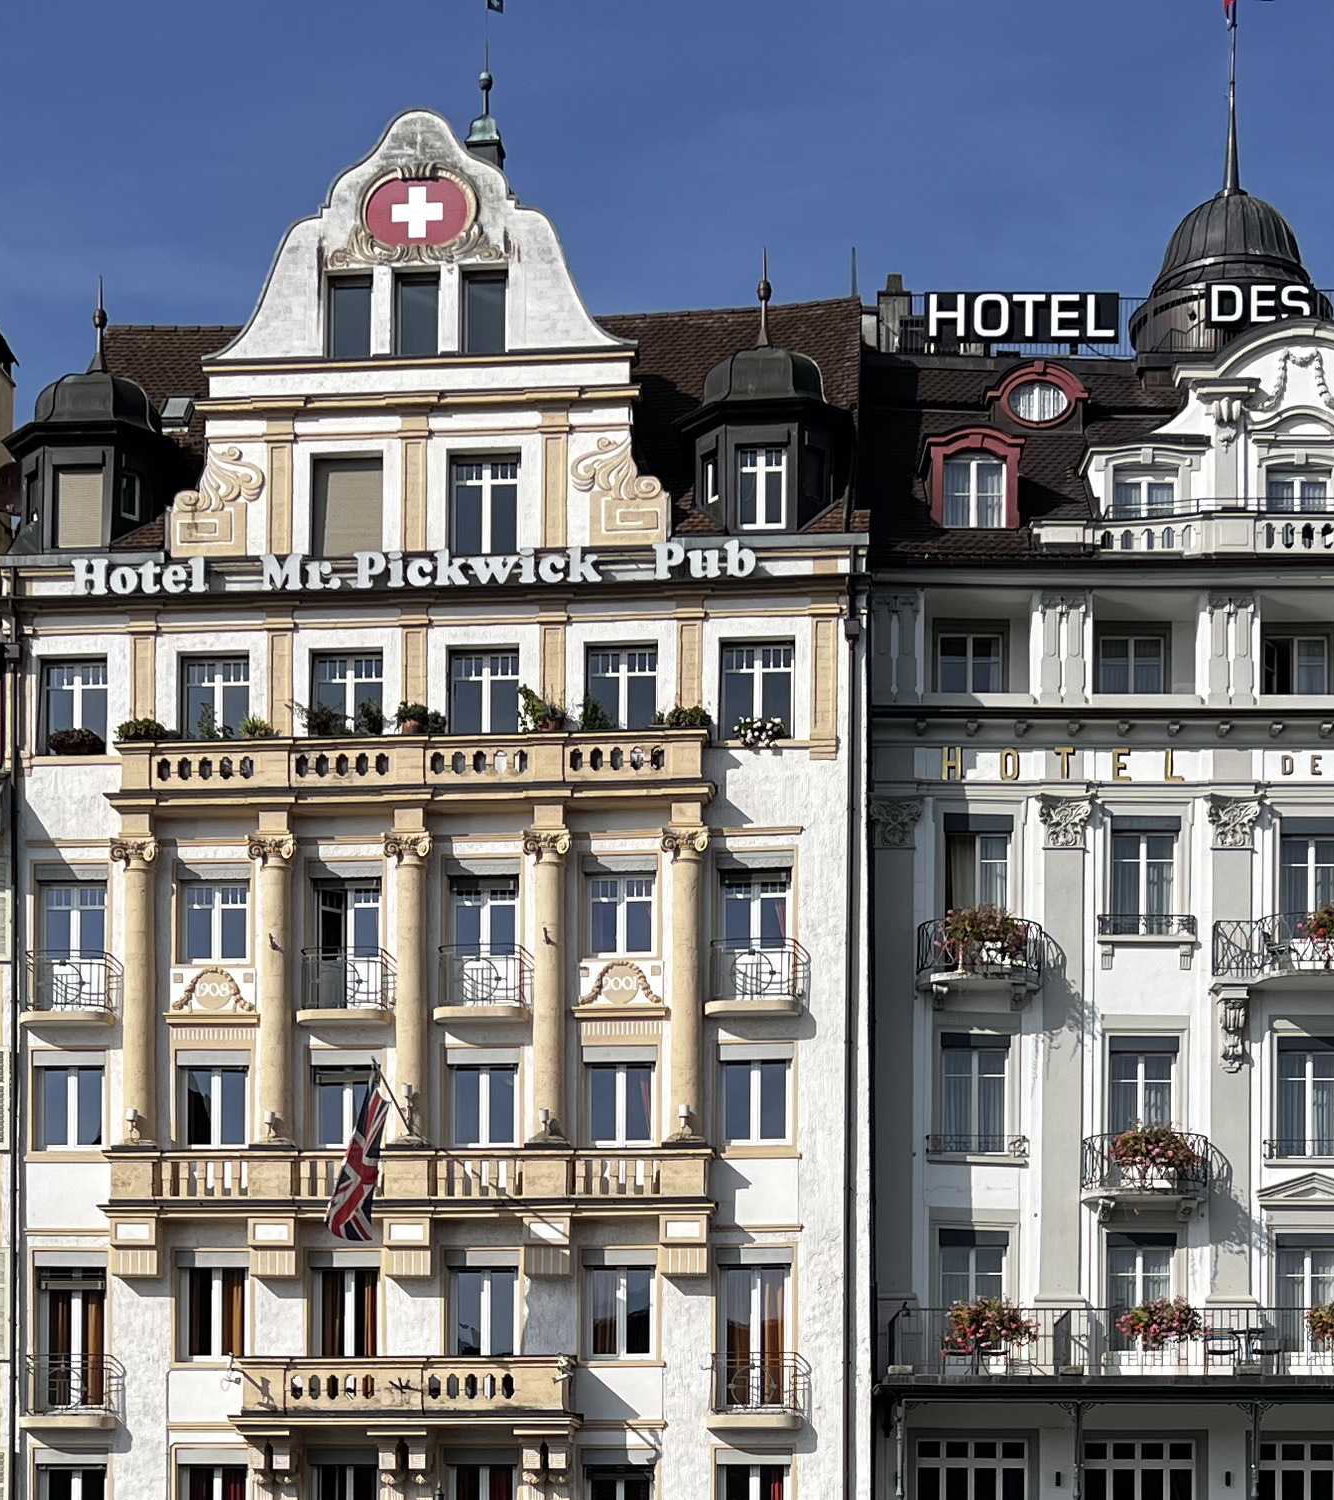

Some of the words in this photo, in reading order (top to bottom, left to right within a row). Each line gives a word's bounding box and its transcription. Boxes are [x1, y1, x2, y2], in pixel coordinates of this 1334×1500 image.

[928, 293, 1116, 338] HOTEL
[1210, 285, 1312, 323] DES
[70, 556, 209, 596] Hotel
[260, 552, 343, 592] Mr.
[353, 546, 603, 590] Pickwick
[652, 538, 758, 582] Pub
[941, 746, 1185, 782] HOTEL
[197, 982, 230, 998] 1908
